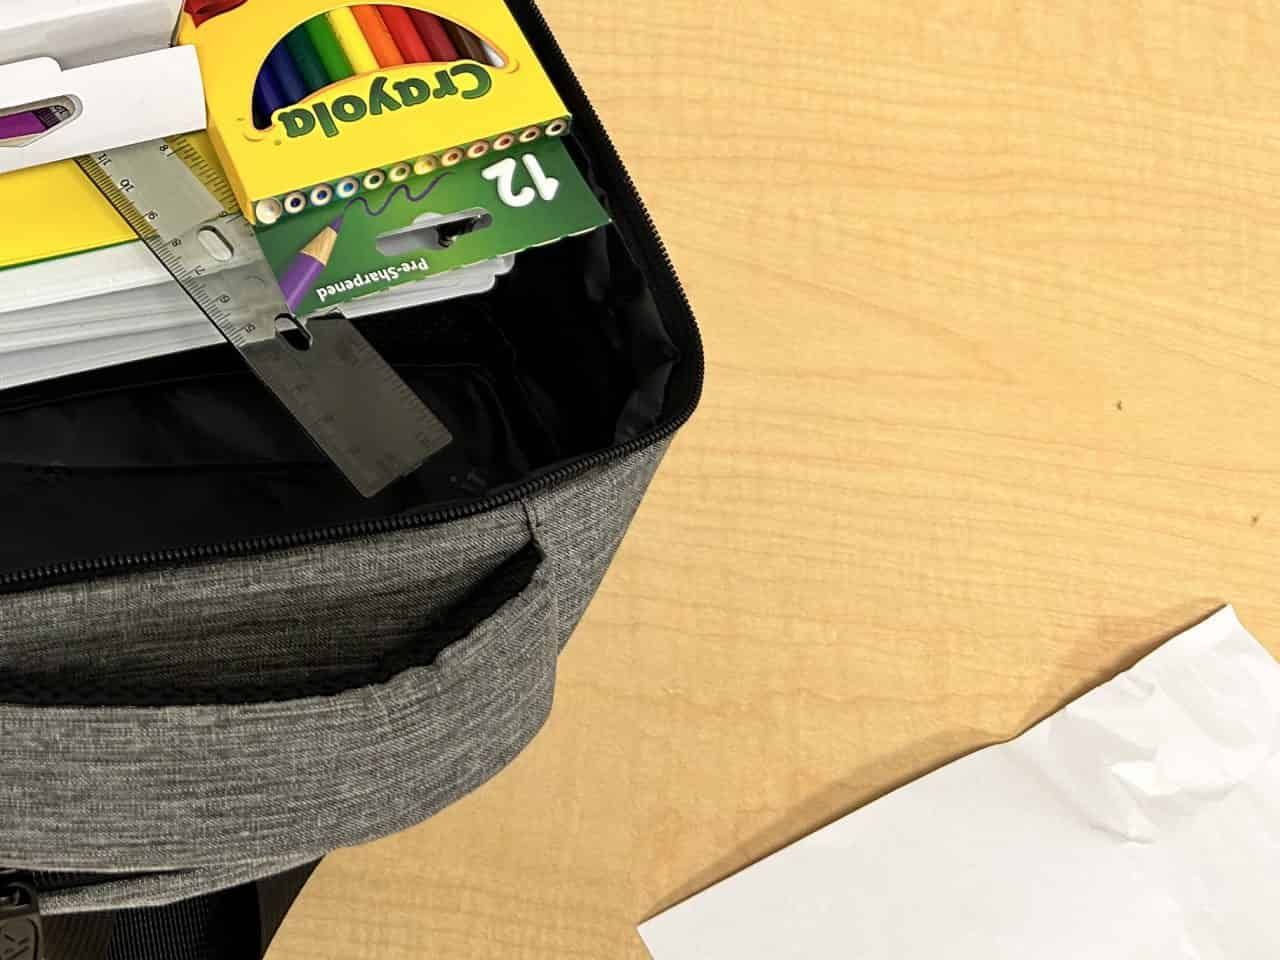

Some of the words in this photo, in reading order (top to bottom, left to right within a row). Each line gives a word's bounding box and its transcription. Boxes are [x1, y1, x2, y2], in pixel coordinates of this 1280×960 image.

[278, 64, 492, 138] Crayola
[481, 153, 560, 208] 12
[316, 257, 429, 302] Pre-Sharpened
